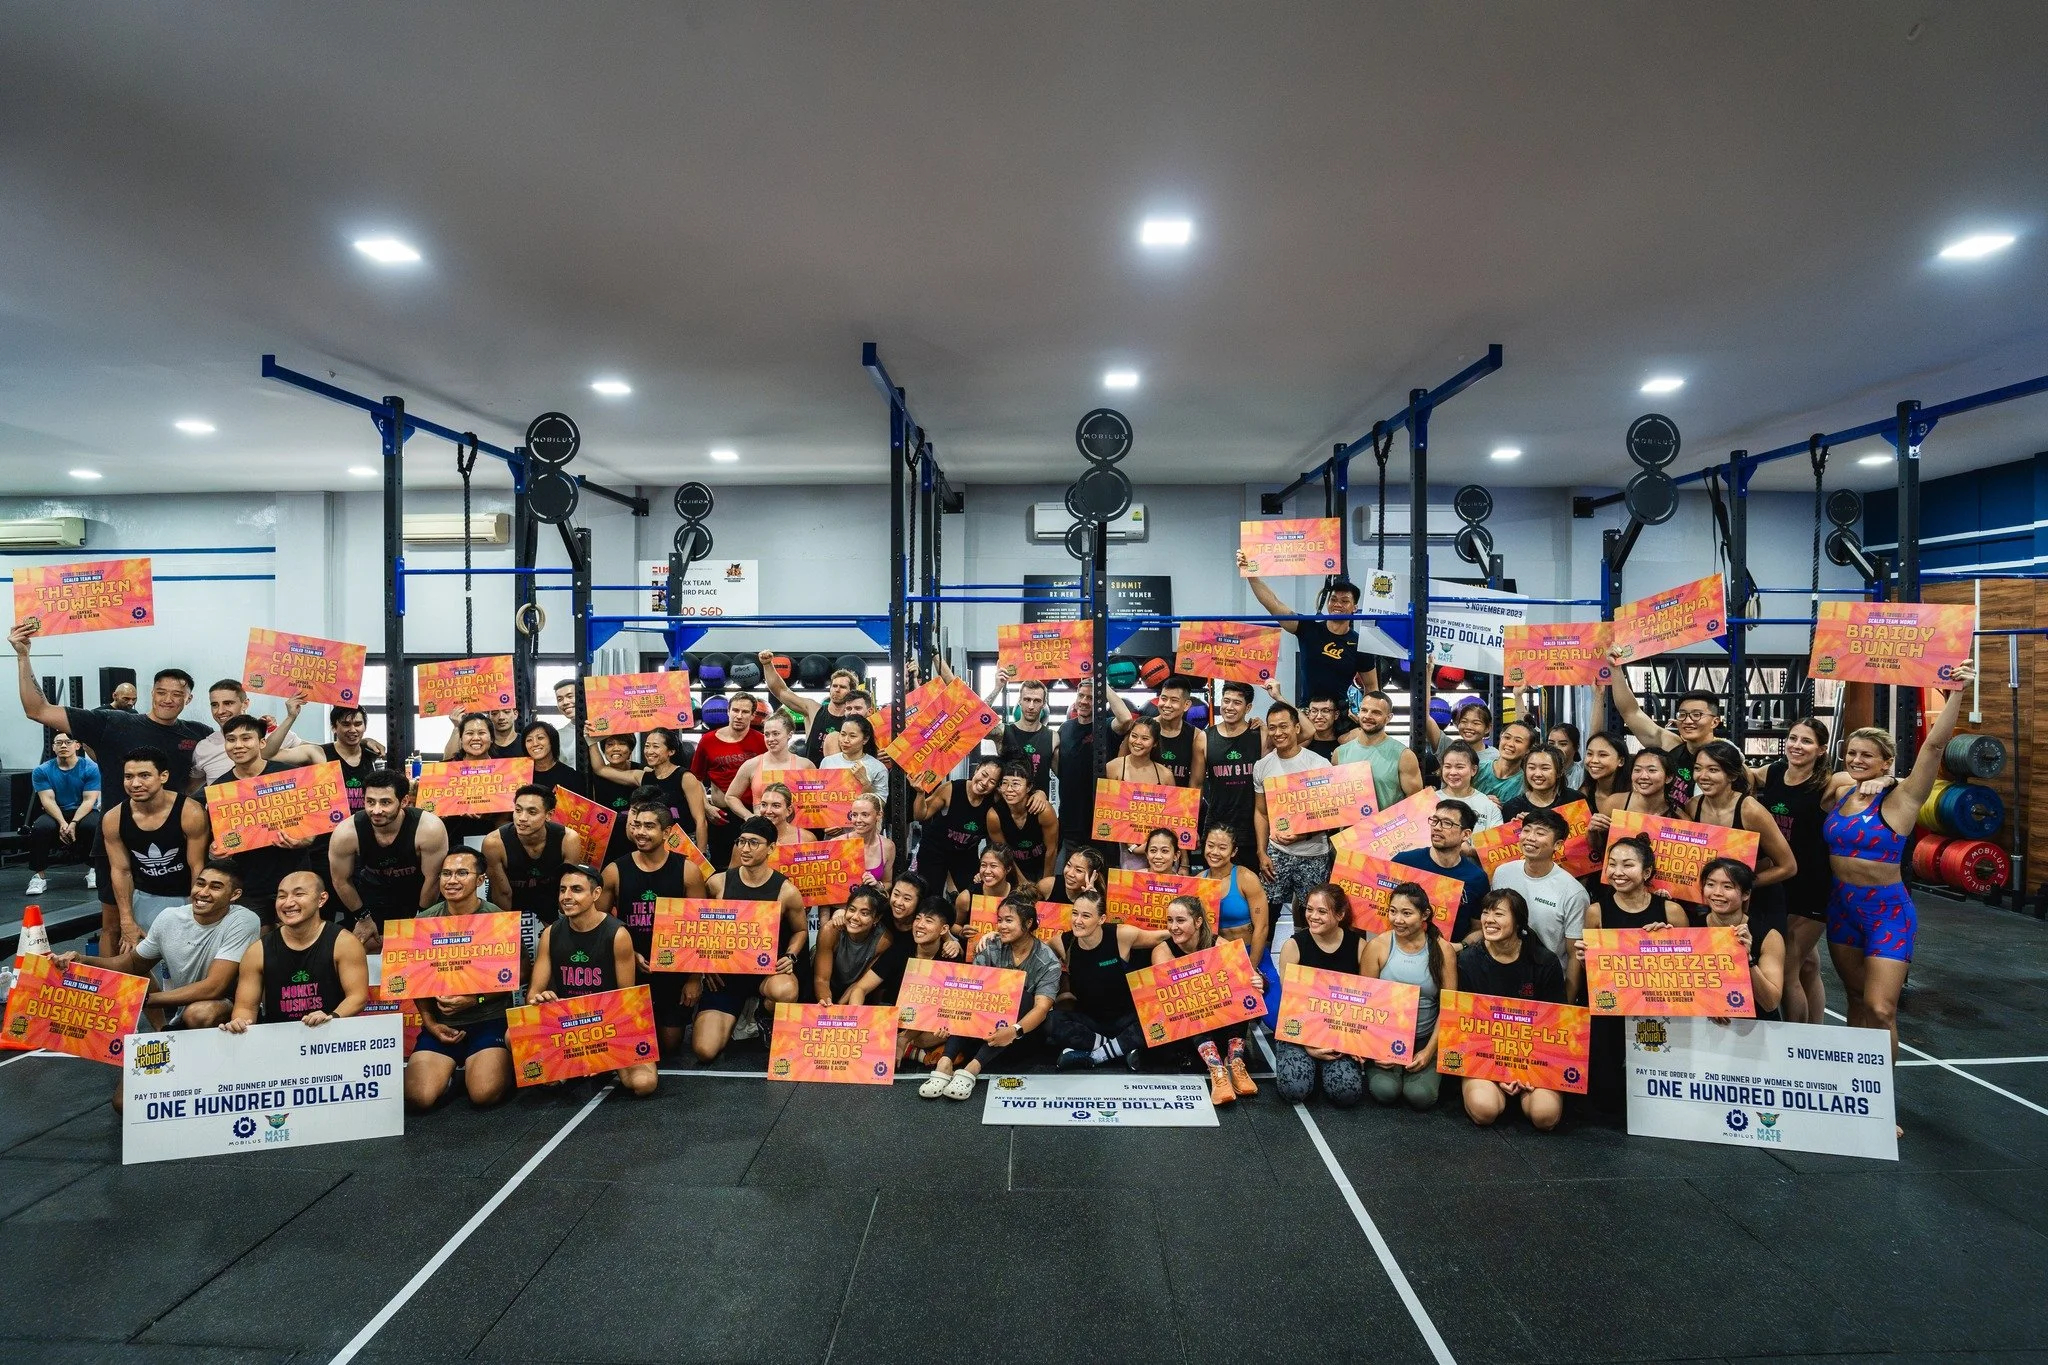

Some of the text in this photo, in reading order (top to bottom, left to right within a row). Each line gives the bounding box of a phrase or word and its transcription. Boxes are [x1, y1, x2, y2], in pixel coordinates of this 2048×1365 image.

[1083, 433, 1127, 441] MOBILUS
[1256, 541, 1325, 552] TEAM ZOE
[35, 579, 131, 600] THE TWIN
[43, 593, 124, 613] TOWERS
[1471, 603, 1505, 616] NOVEMBER
[1506, 609, 1523, 619] 2023
[1629, 595, 1709, 630] TEAM HWA
[1642, 613, 1695, 637] CHONG
[1845, 623, 1936, 642] BRAIDY
[1021, 638, 1073, 651] WIN OR
[1184, 639, 1223, 654] QUAY
[1223, 646, 1236, 657] &
[1322, 642, 1344, 660] Cal
[1848, 640, 1925, 659] BUNCH
[272, 651, 339, 672] CANVAS
[1024, 650, 1070, 662] BOOZE
[1516, 648, 1605, 660] TOHEARLY
[269, 664, 337, 684] CLOWNS
[427, 672, 505, 691] DAVID AND
[435, 684, 498, 699] GOLIATH
[913, 730, 947, 765] BUNZ
[947, 704, 971, 732] OUT
[217, 782, 337, 812] TROUBLE IN
[791, 790, 857, 802] NTI CALI
[1275, 779, 1364, 806] UNDER THE
[230, 798, 331, 830] PARADISE
[1129, 801, 1165, 813] BABY
[1095, 807, 1197, 828] CROSSFITTERS
[1370, 833, 1393, 852] PB
[1393, 829, 1406, 843] &
[1409, 823, 1419, 835] J
[1660, 832, 1707, 845] SCALED TEAM WOMEN
[140, 862, 185, 877] adidas
[779, 860, 841, 875] POTATO
[1534, 897, 1557, 908] MOBILUS
[674, 920, 760, 935] THE NASI
[658, 935, 773, 951] LEMAK BOYS
[385, 941, 517, 964] DE-LULULIMAU
[1598, 954, 1735, 971] ENERGIZER
[560, 966, 602, 987] TACOS
[1612, 972, 1722, 989] BUNNIES
[281, 982, 319, 1000] MONKEY
[909, 983, 941, 996] TEAM
[1155, 974, 1213, 1001] DUTCH
[40, 982, 116, 1012] MONKEY
[280, 996, 324, 1013] BUSINESS
[910, 993, 1007, 1015] LIFE CHANGING
[1161, 985, 1233, 1017] DANISH
[24, 998, 119, 1034] BUSINESS
[1308, 996, 1389, 1025] TRY TRY
[1501, 1013, 1514, 1021] TEAM
[1515, 1015, 1531, 1023] WOMEN
[550, 1022, 617, 1048] TACOS
[799, 1027, 870, 1043] GEMINI
[1459, 1016, 1569, 1046] WHALE-LI
[1637, 1020, 1665, 1033] DOUBLE
[1635, 1031, 1667, 1043] TROUBLE
[137, 1040, 170, 1056] DOUBLE
[300, 1037, 396, 1056] 5 NOVEMBER 2023
[802, 1043, 863, 1060] CHAOS
[1491, 1036, 1534, 1057] TRY
[134, 1050, 171, 1070] TROUBLE
[1787, 1047, 1884, 1066] 5 NOVEMBER 2023
[363, 1063, 391, 1078] $100
[218, 1074, 343, 1093] 2ND RUNNER UP MEN SC DIVISION
[1704, 1072, 1838, 1091] 2ND RUNNER UP WOMEN SC DIVISION
[1851, 1078, 1881, 1094] $100
[134, 1093, 148, 1101] PAY
[172, 1089, 193, 1097] ORDER
[146, 1081, 379, 1120] ONE HUNDRED DOLLARS
[1647, 1078, 1869, 1115] ONE HUNDRED DOLLARS
[1001, 1100, 1195, 1110] TWO HUNDRED DOLLARS
[265, 1129, 290, 1137] MATE
[265, 1135, 289, 1143] MATE
[1722, 1131, 1754, 1139] MOBILUS
[1756, 1127, 1782, 1136] MATE
[1756, 1134, 1782, 1143] MATE
[229, 1139, 261, 1147] MOBILUS
